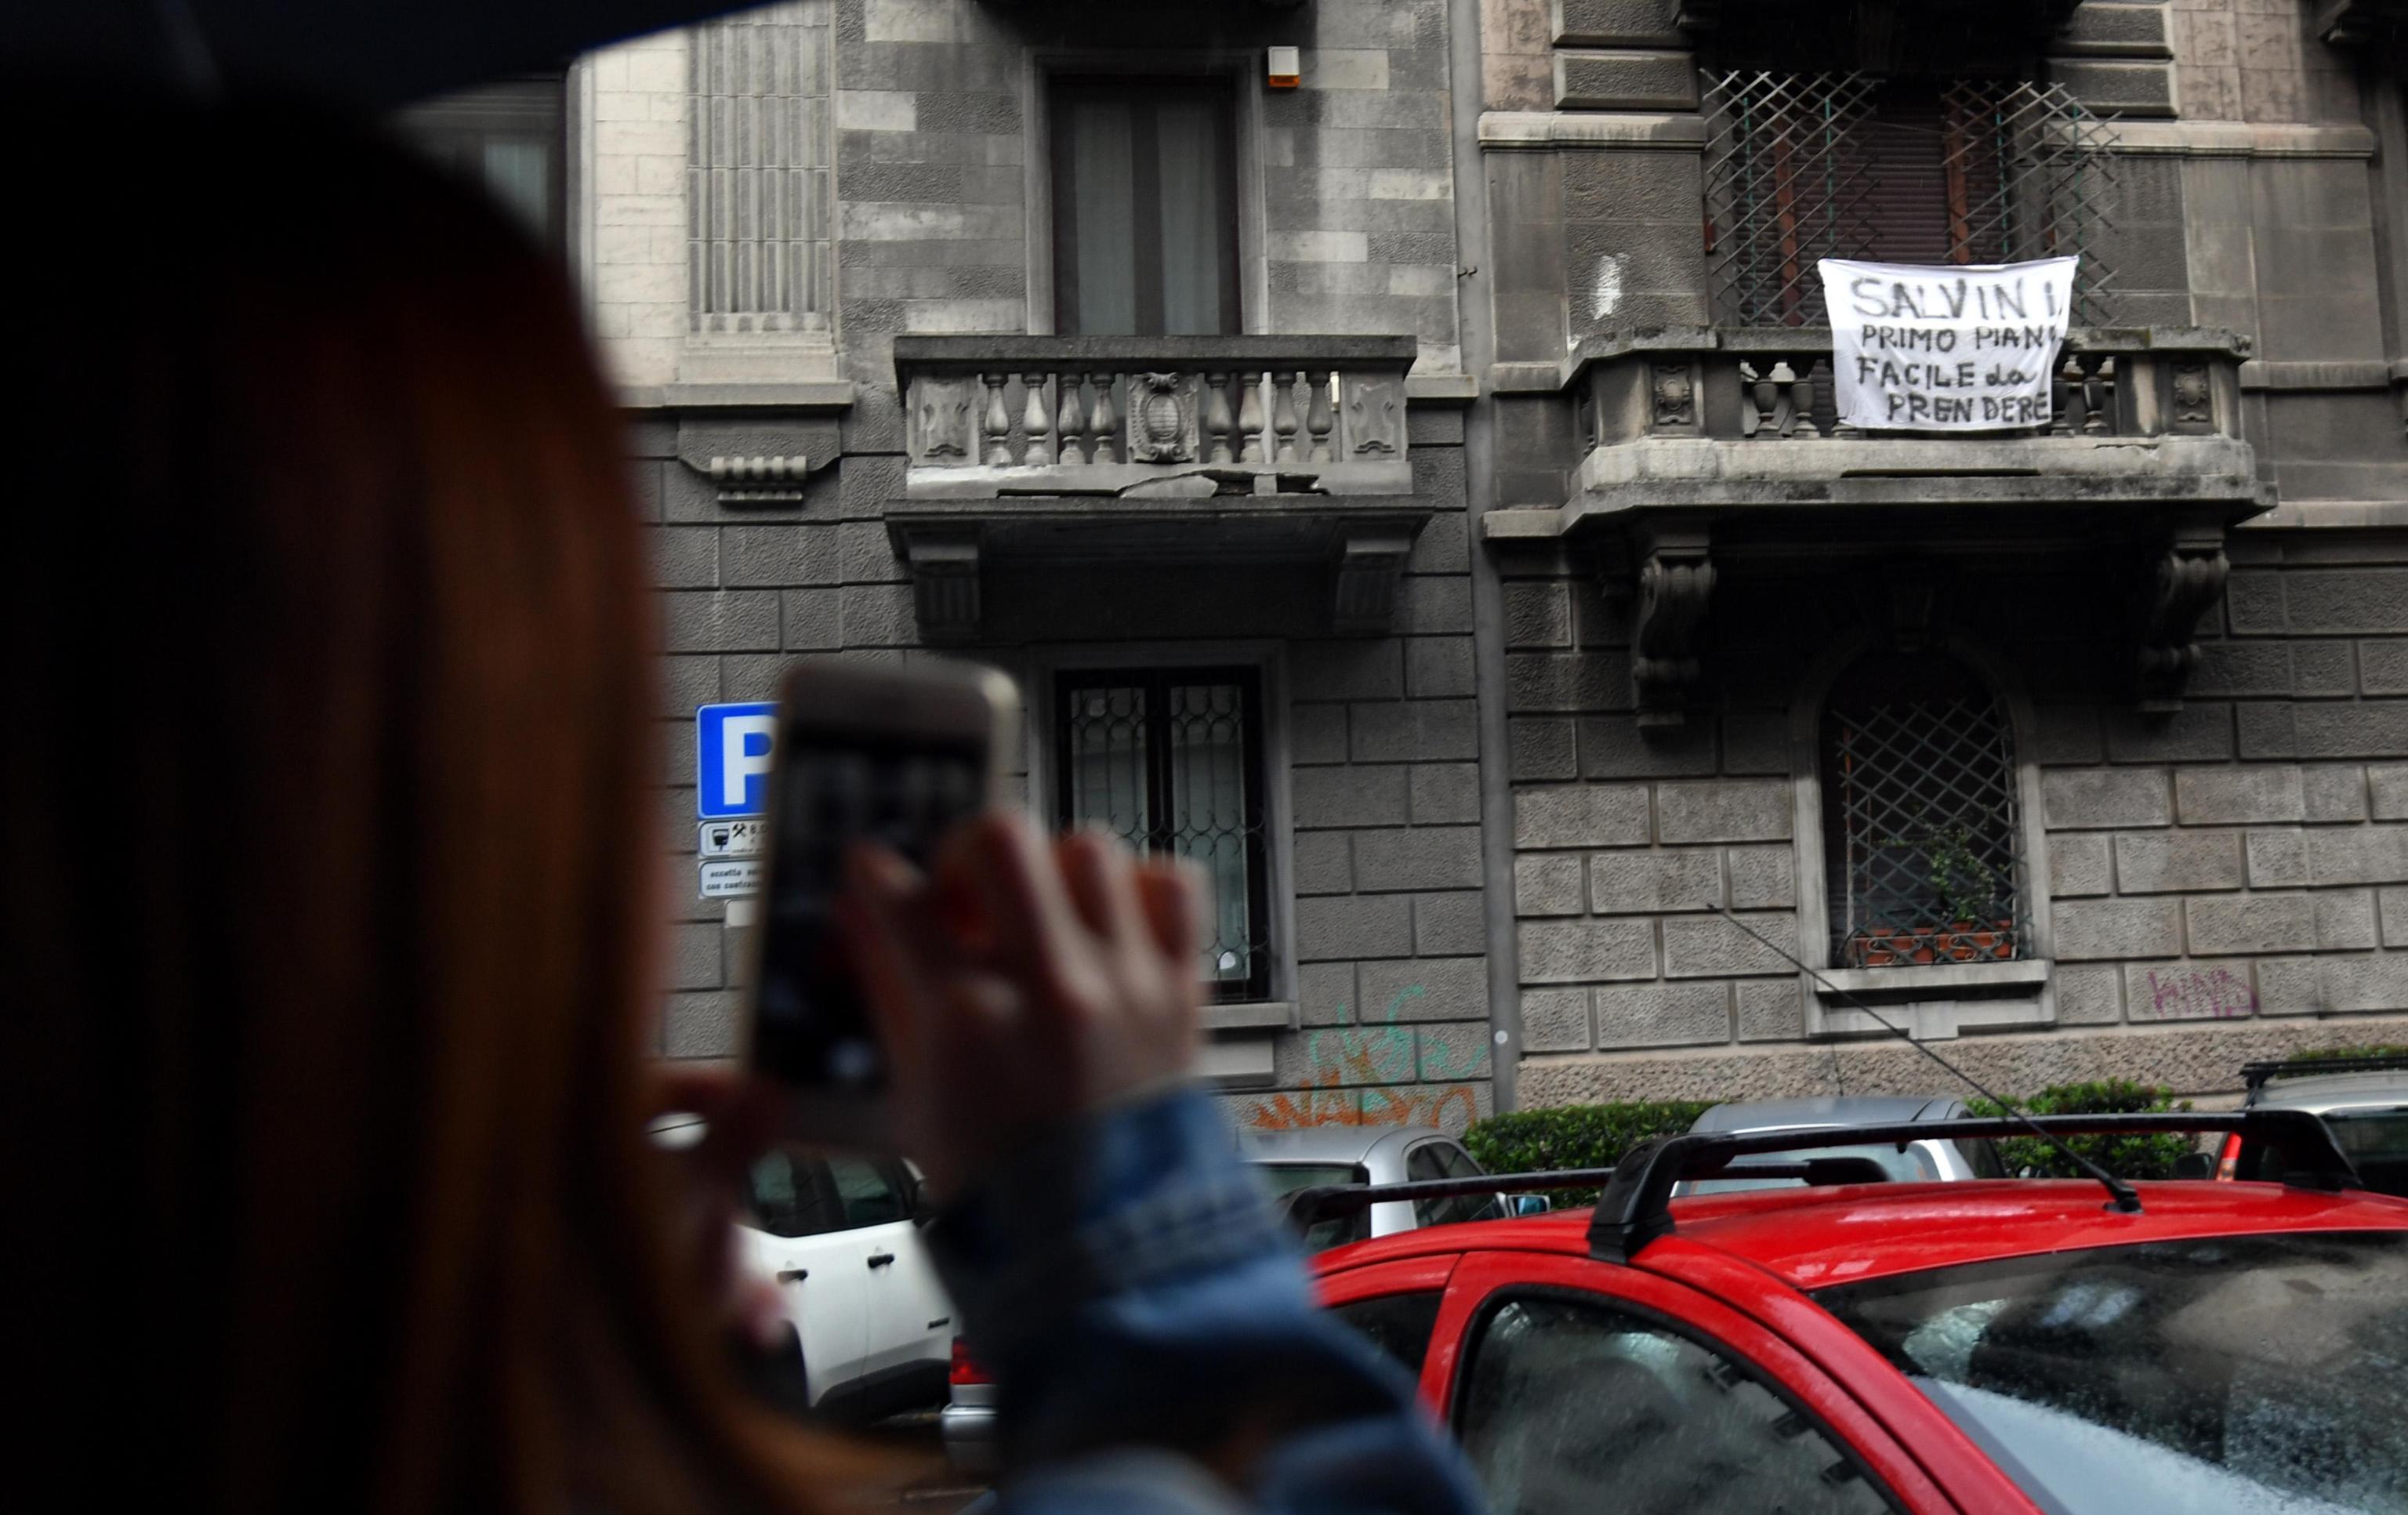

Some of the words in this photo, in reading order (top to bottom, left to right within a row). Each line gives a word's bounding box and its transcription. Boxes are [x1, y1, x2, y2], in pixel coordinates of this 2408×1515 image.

[1850, 277, 2055, 320] SALVINI
[1862, 324, 1956, 352] PRIMO
[1856, 357, 1975, 388] FACILE
[1985, 364, 2037, 386] da
[1887, 392, 2050, 423] PRENDERE
[723, 714, 777, 806] P
